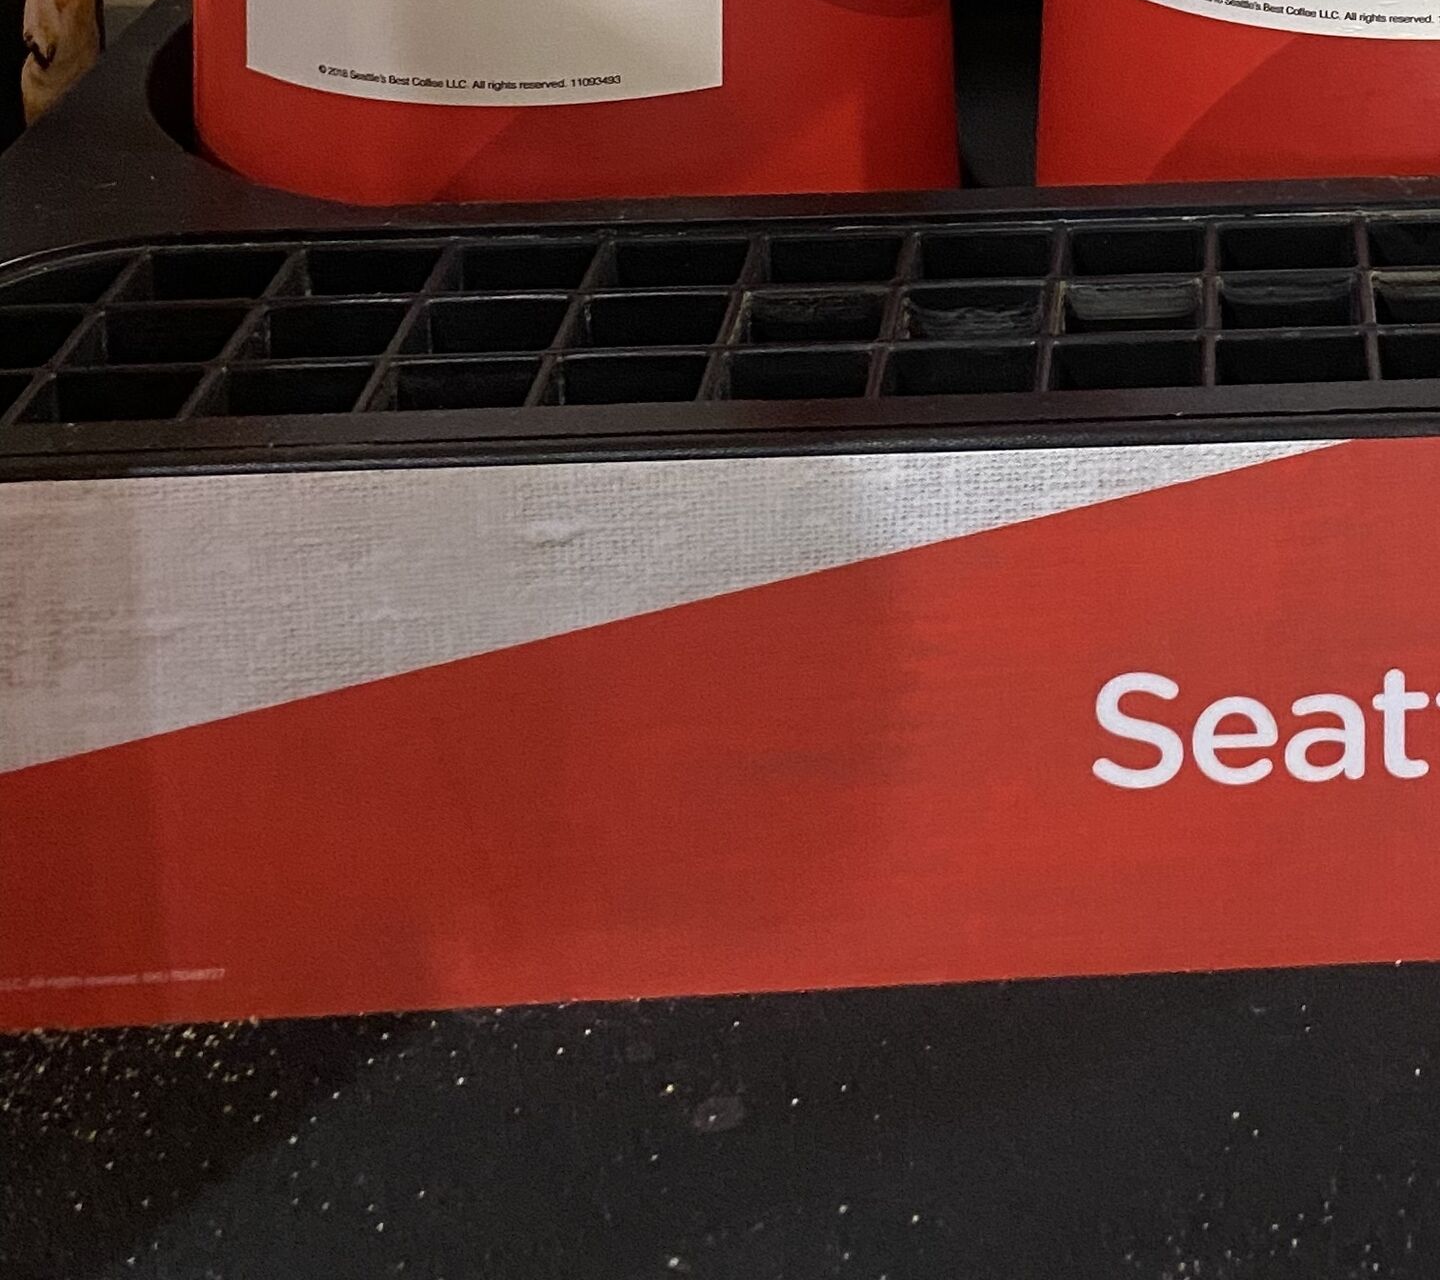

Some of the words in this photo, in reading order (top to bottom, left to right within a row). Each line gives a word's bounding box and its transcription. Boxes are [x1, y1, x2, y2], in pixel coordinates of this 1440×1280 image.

[1344, 11, 1357, 21] All
[1359, 13, 1387, 24] rights
[488, 80, 516, 92] rights
